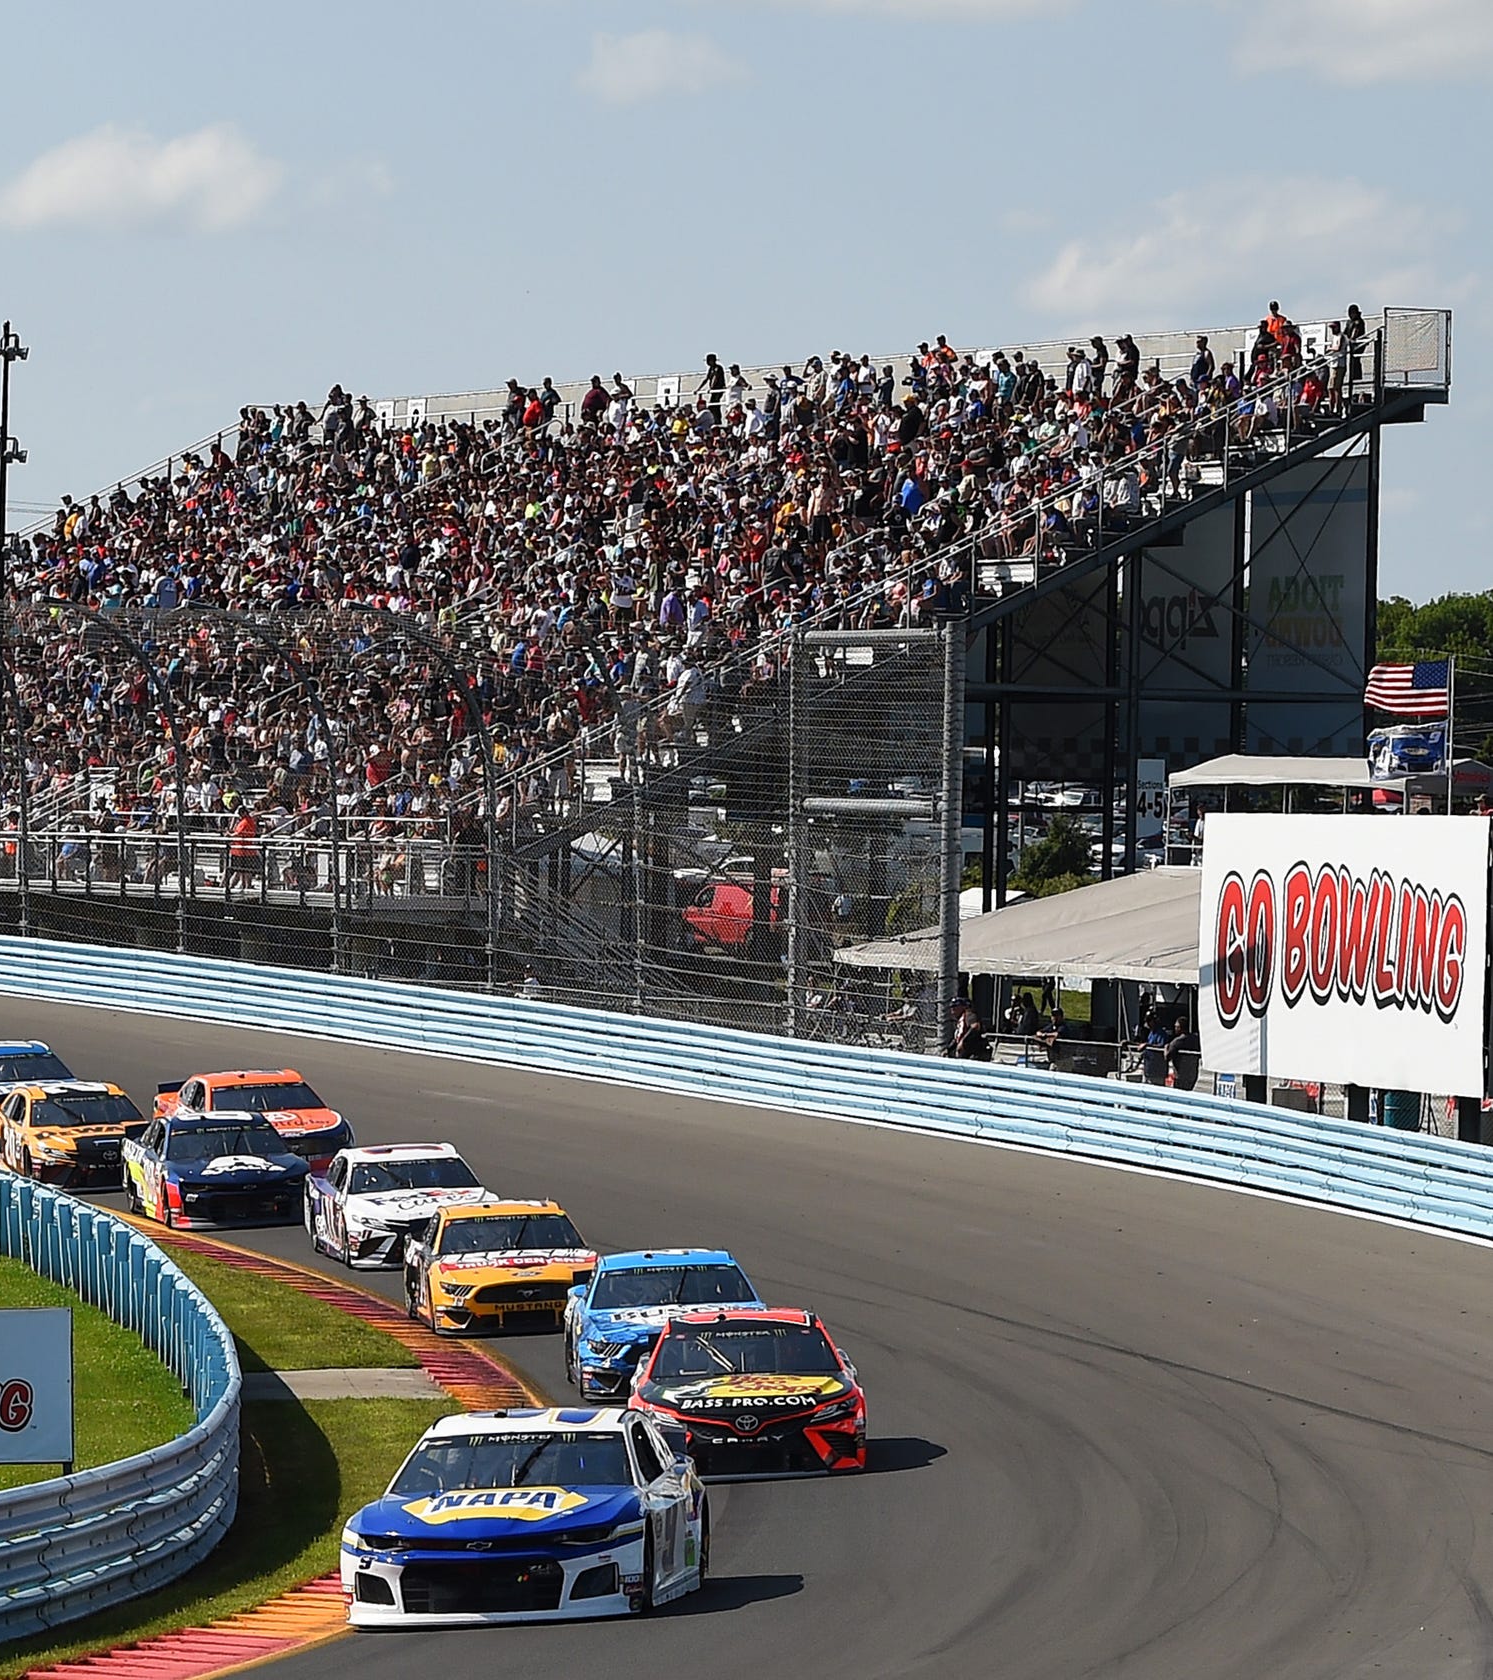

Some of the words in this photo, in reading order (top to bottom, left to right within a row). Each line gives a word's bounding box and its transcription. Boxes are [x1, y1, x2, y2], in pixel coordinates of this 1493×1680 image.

[1306, 337, 1317, 359] 5
[1215, 869, 1277, 1030] GO
[1281, 860, 1467, 1025] BOWLING
[494, 1302, 563, 1311] MUSTANG
[715, 1330, 771, 1338] MONSTER
[712, 1435, 782, 1445] CARY
[431, 1491, 557, 1513] NAPA
[358, 1556, 373, 1570] 9
